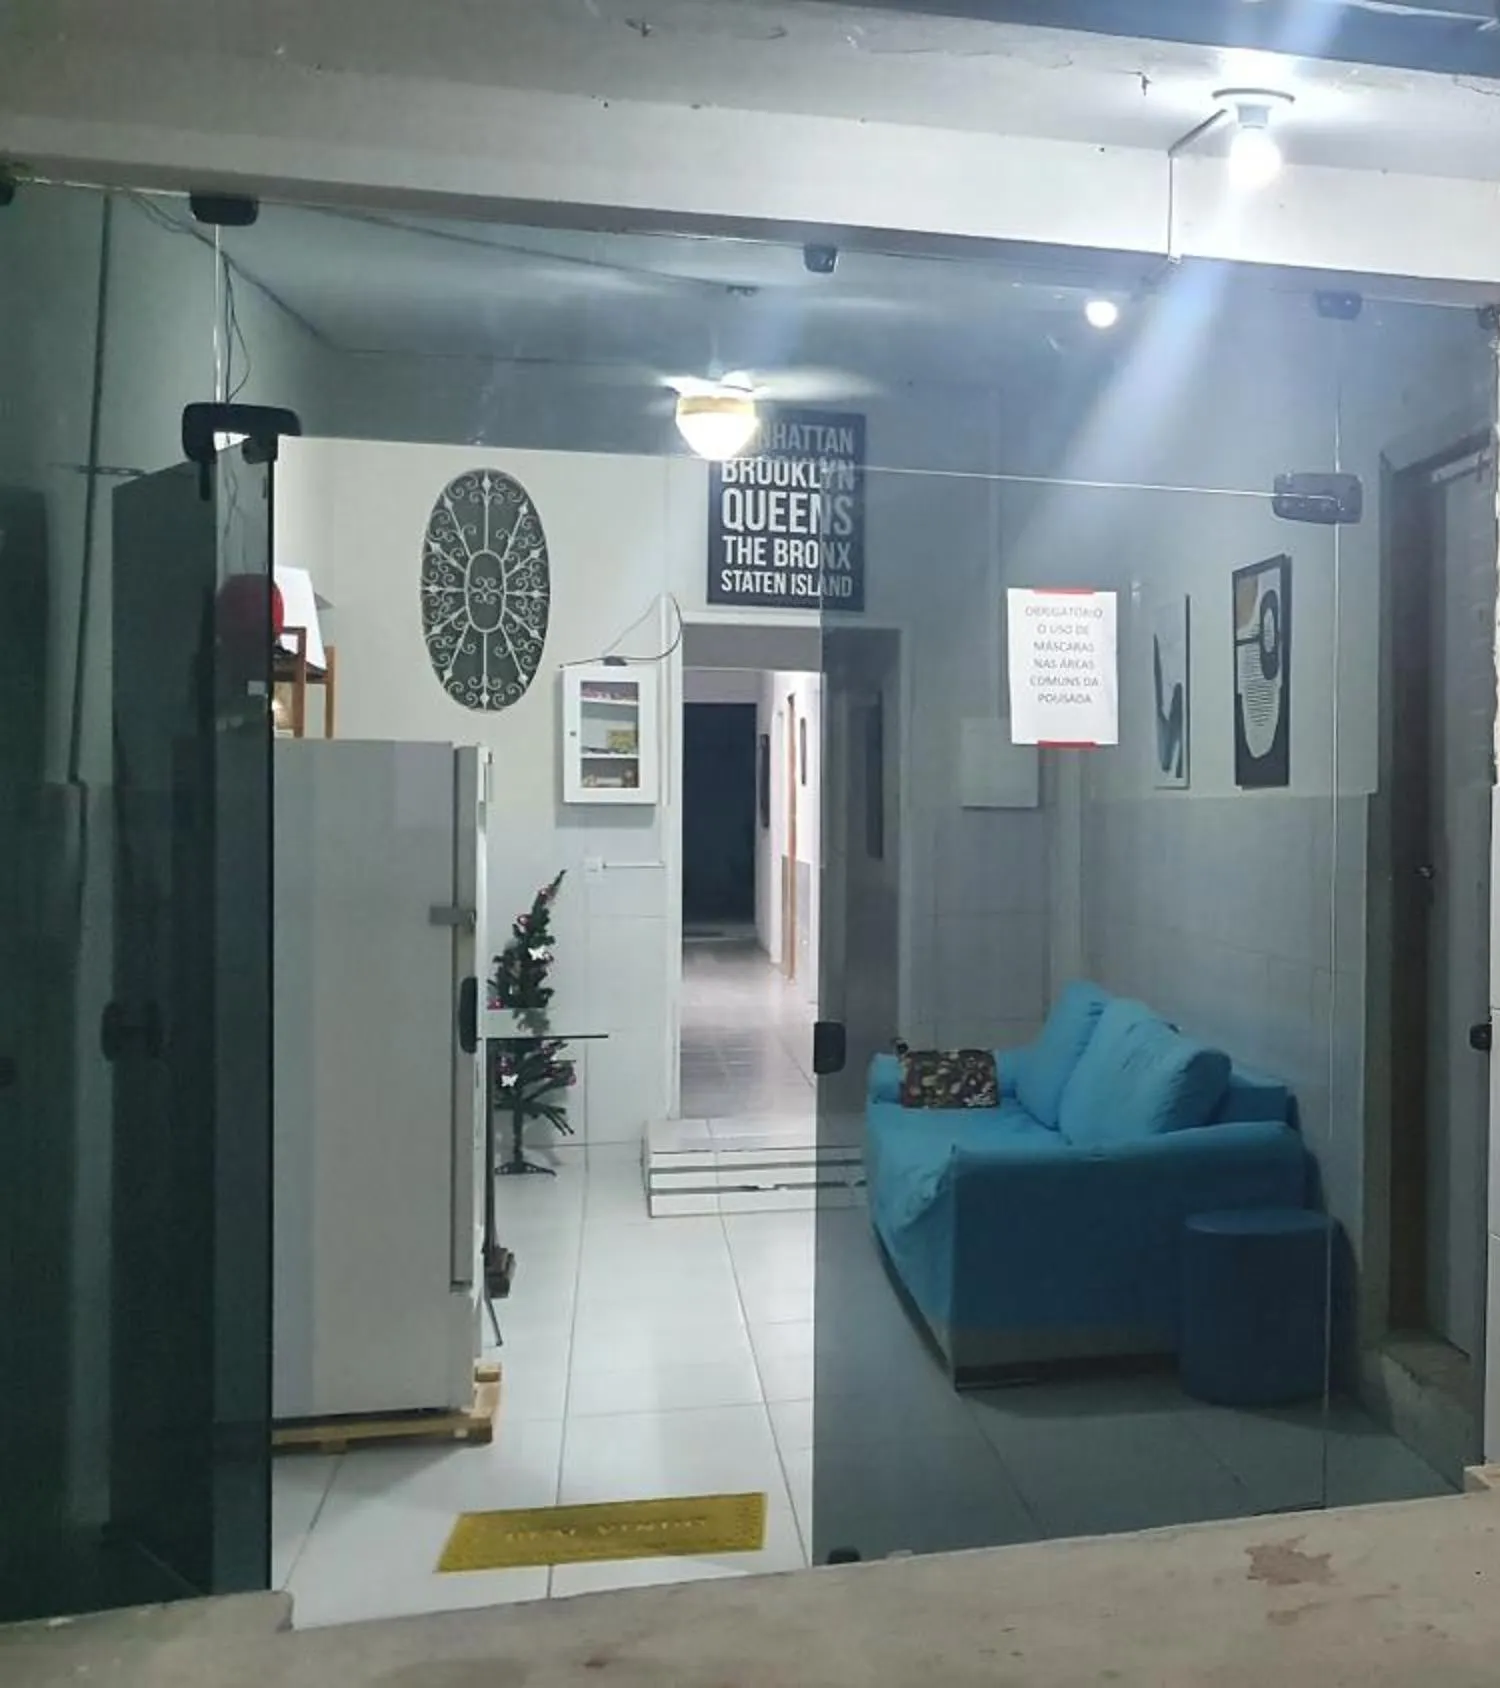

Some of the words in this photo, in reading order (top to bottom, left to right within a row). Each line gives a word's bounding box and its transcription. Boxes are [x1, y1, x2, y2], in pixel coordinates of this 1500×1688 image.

[757, 421, 854, 455] NHATTAN
[721, 456, 855, 490] BROOKLYN
[722, 488, 854, 535] QUEENS
[722, 535, 767, 566] THE
[773, 539, 851, 571] BRONX
[720, 569, 786, 594] STATEN
[791, 571, 852, 597] ISLAND
